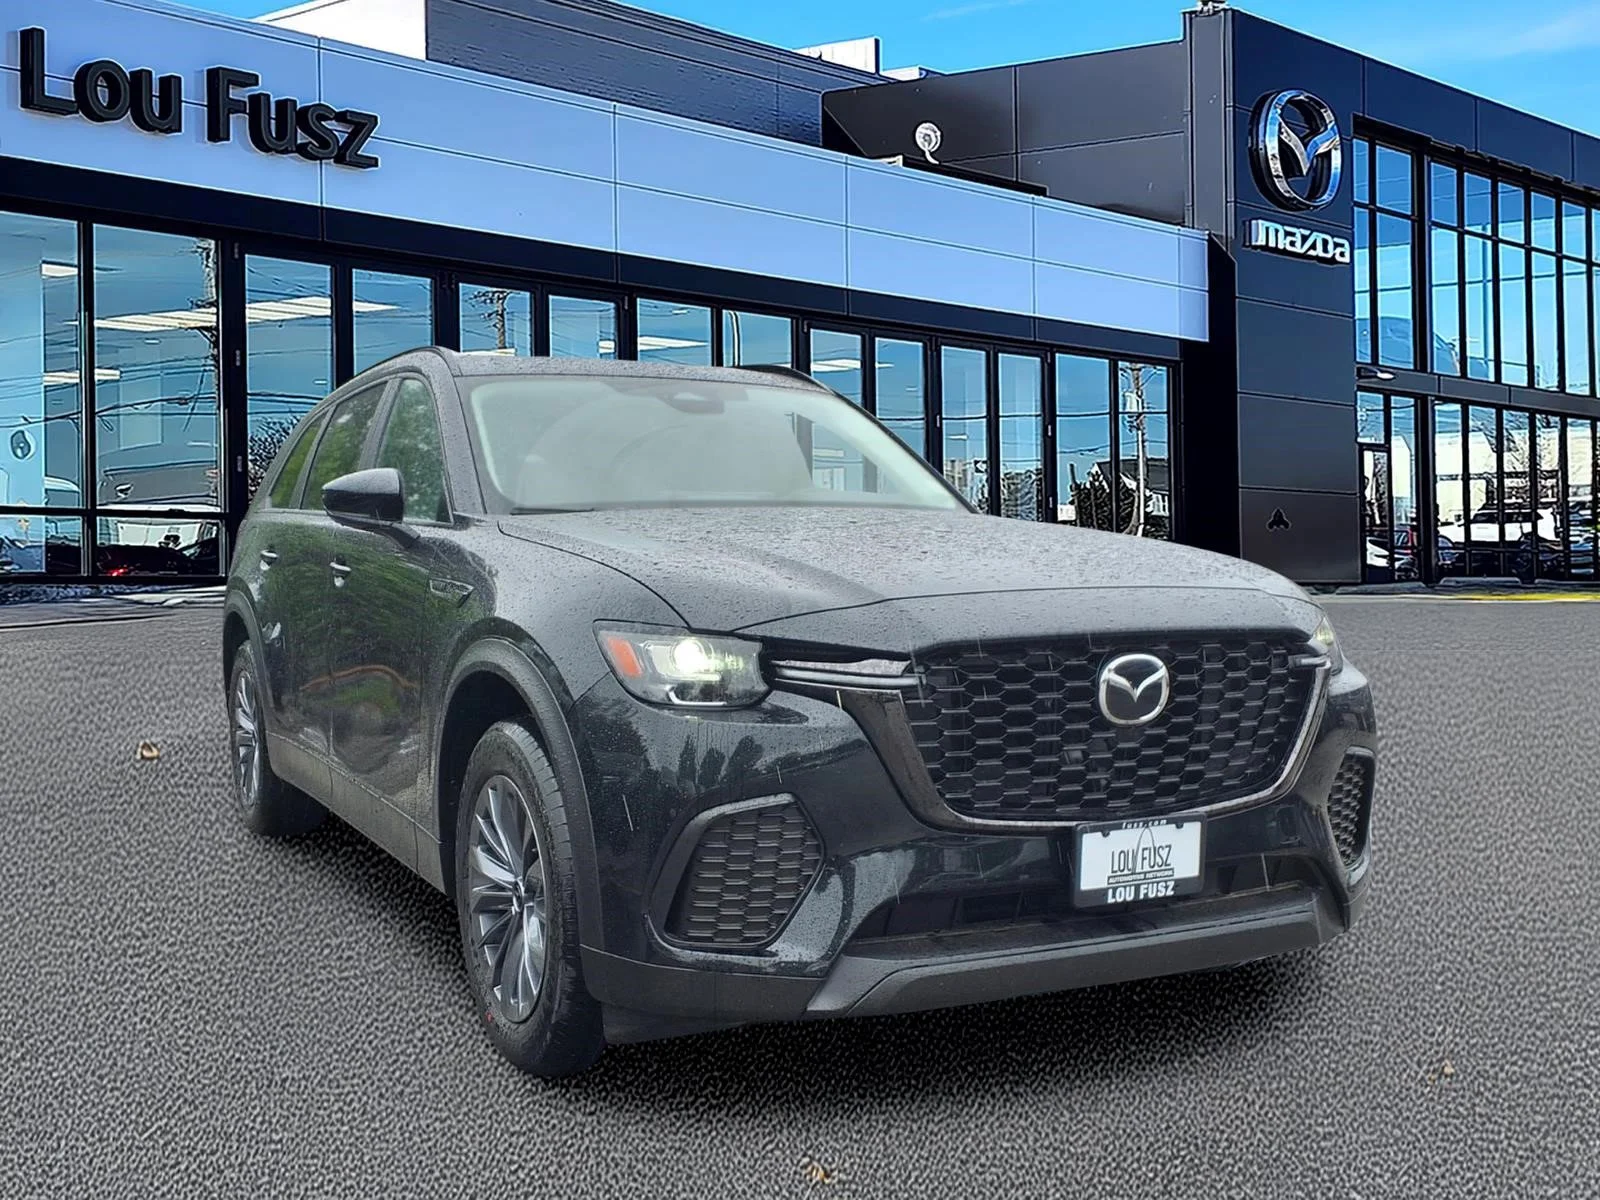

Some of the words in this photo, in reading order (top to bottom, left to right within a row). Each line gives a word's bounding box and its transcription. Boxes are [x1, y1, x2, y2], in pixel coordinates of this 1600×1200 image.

[18, 26, 182, 134] Lou
[205, 66, 379, 169] Fusz
[1111, 847, 1135, 874] LOU
[1140, 844, 1172, 870] FUSZ
[1107, 885, 1135, 903] LOU
[1139, 881, 1175, 899] FUSZ
